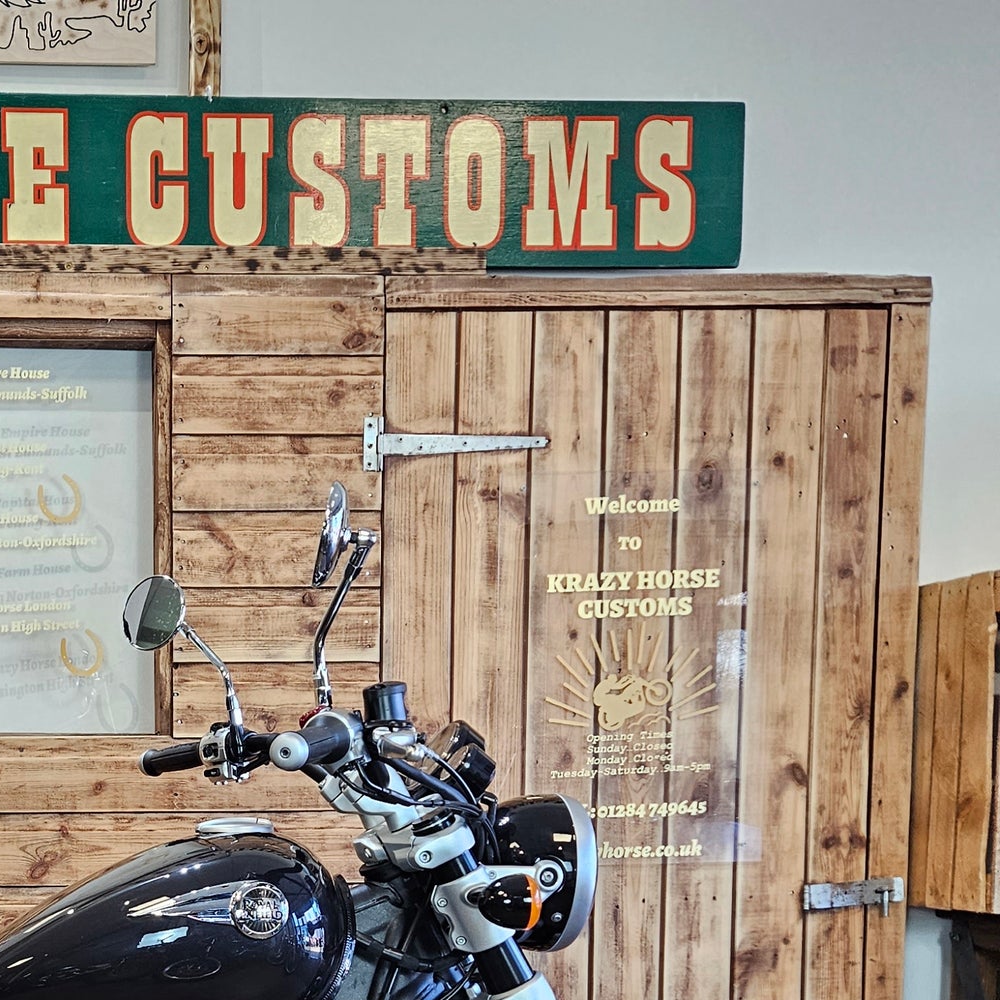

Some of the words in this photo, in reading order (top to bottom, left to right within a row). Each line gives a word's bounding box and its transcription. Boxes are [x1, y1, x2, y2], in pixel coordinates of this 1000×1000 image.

[125, 111, 697, 253] CUSTOMS
[9, 366, 50, 380] House
[584, 494, 680, 515] Welcome
[617, 536, 642, 550] TO
[547, 571, 633, 593] KRAZY
[636, 568, 721, 590] HORSE
[24, 600, 71, 614] London
[577, 596, 693, 619] CUSTOMS
[10, 620, 41, 635] High
[45, 618, 82, 631] Street
[586, 733, 634, 744] Opening
[640, 731, 673, 740] Times
[649, 800, 707, 818] 749645
[597, 839, 702, 859] horse.co.uk
